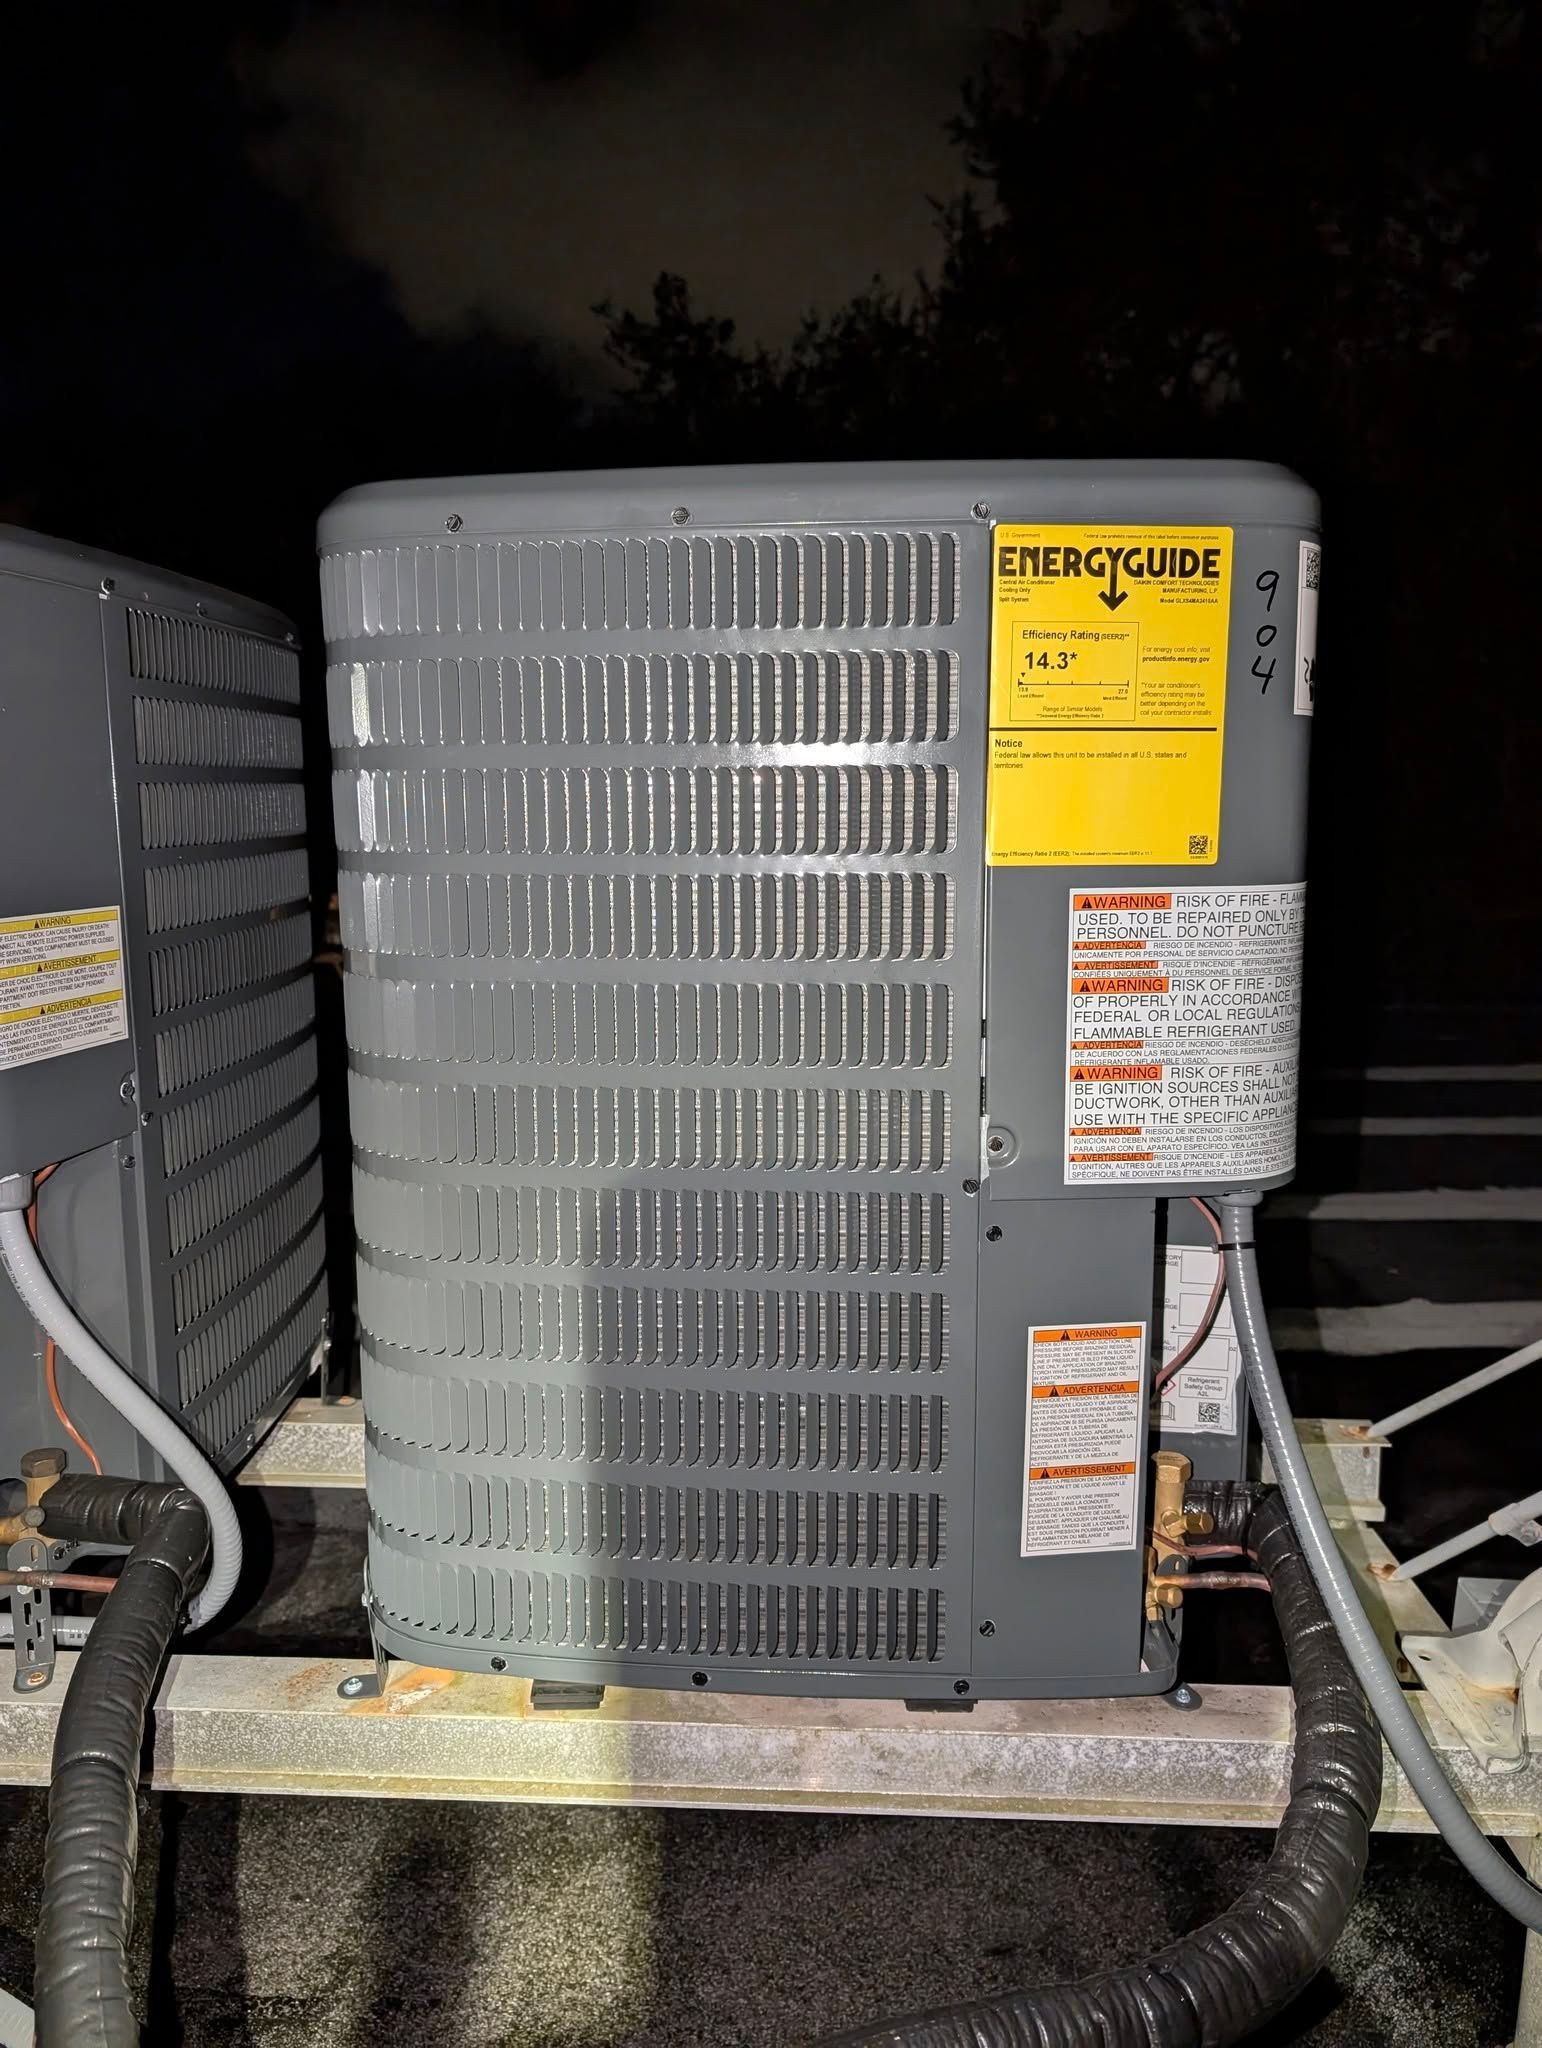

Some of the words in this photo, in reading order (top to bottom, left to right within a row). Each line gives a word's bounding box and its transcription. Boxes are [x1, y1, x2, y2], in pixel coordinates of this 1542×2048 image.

[999, 546, 1220, 578] ENERGYGUIDE
[1023, 630, 1067, 640] Efficiency
[1071, 630, 1099, 641] Rating
[995, 739, 1022, 748] Notice
[1095, 896, 1166, 908] WARNING
[1177, 896, 1210, 907] RISK
[1215, 895, 1235, 907] OF
[1240, 895, 1269, 906] FIRE
[40, 916, 71, 927] WARNING
[1079, 913, 1122, 925] USED.
[1130, 912, 1148, 924] TO
[1153, 912, 1172, 923] BE
[1177, 912, 1250, 923] REPAIRED
[1256, 910, 1285, 922] ONLY
[1289, 908, 1299, 919] BY
[1078, 928, 1171, 939] PERSONNEL.
[1177, 926, 1198, 938] DO
[1203, 926, 1234, 937] NOT
[44, 955, 96, 970] AVERTISSEMENT
[1092, 980, 1163, 991] WARNING
[1172, 979, 1205, 991] RISK
[1210, 979, 1230, 990] OF
[1234, 979, 1264, 989] FIRE
[47, 998, 92, 1013] ADVERTENCIA
[1074, 997, 1092, 1008] OF
[1097, 995, 1178, 1007] PROPERLY
[1183, 995, 1196, 1006] IN
[1201, 991, 1290, 1005] ACCORDANCE
[1075, 1011, 1141, 1022] FEDERAL
[1148, 1010, 1169, 1021] OR
[1174, 1009, 1222, 1021] LOCAL
[1227, 1004, 1300, 1020] REGULATIONS
[1075, 1027, 1162, 1039] FLAMMABLE
[1168, 1024, 1267, 1037] REFRIGERANT
[1088, 1067, 1158, 1079] WARNING
[1171, 1067, 1206, 1078] RISK
[1209, 1066, 1228, 1078] OF
[1233, 1066, 1262, 1077] FIRE
[1075, 1084, 1093, 1095] BE
[1099, 1083, 1162, 1094] IGNITION
[1168, 1082, 1238, 1093] SOURCES
[1243, 1078, 1280, 1090] SHALL
[1282, 1074, 1297, 1086] NOT
[1075, 1097, 1164, 1109] DUCTWORK,
[1169, 1096, 1219, 1107] OTHER
[1224, 1094, 1259, 1106] THAN
[1075, 1114, 1103, 1125] USE
[1108, 1113, 1145, 1125] WITH
[1151, 1113, 1178, 1124] THE
[1184, 1111, 1249, 1123] SPECIFIC
[1075, 1329, 1117, 1338] WARNING
[1063, 1384, 1125, 1394] ADVERTENCIA
[1053, 1465, 1126, 1476] AVERTISSEMENT
